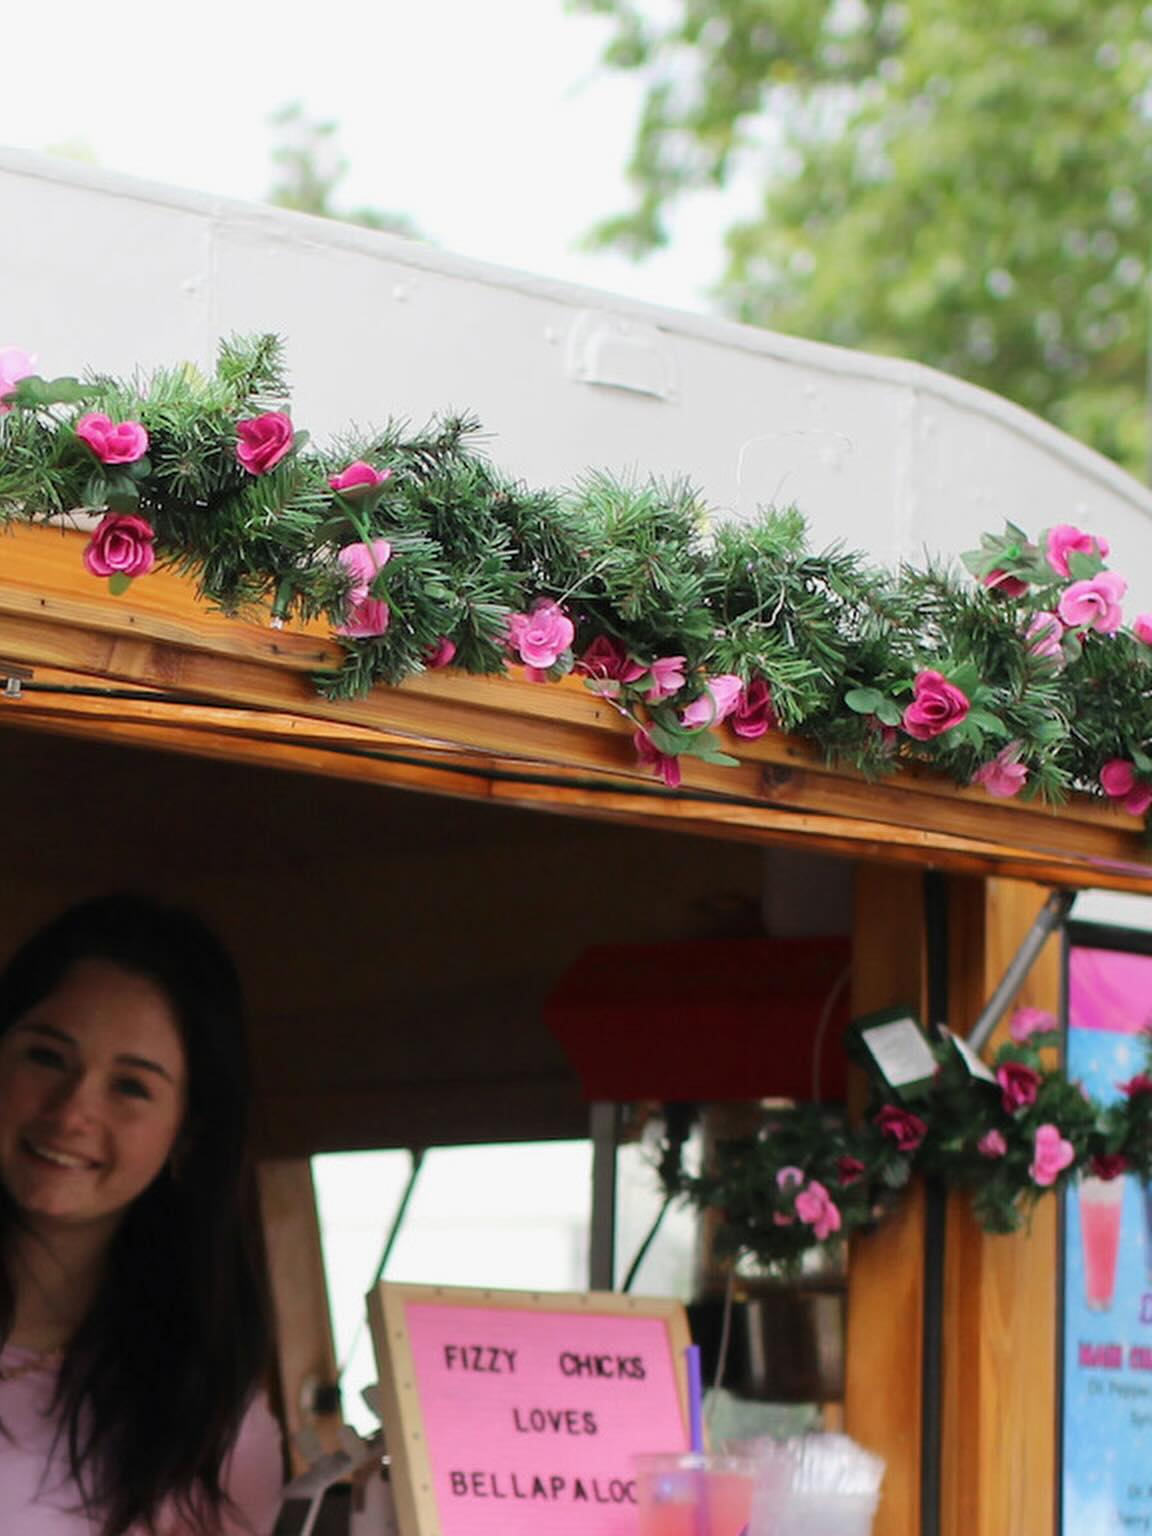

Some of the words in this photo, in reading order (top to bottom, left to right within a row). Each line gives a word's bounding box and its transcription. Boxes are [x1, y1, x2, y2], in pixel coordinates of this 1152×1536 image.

[444, 1345, 518, 1374] FIZZY
[559, 1352, 647, 1381] CHICKS
[514, 1408, 598, 1436] LOVES
